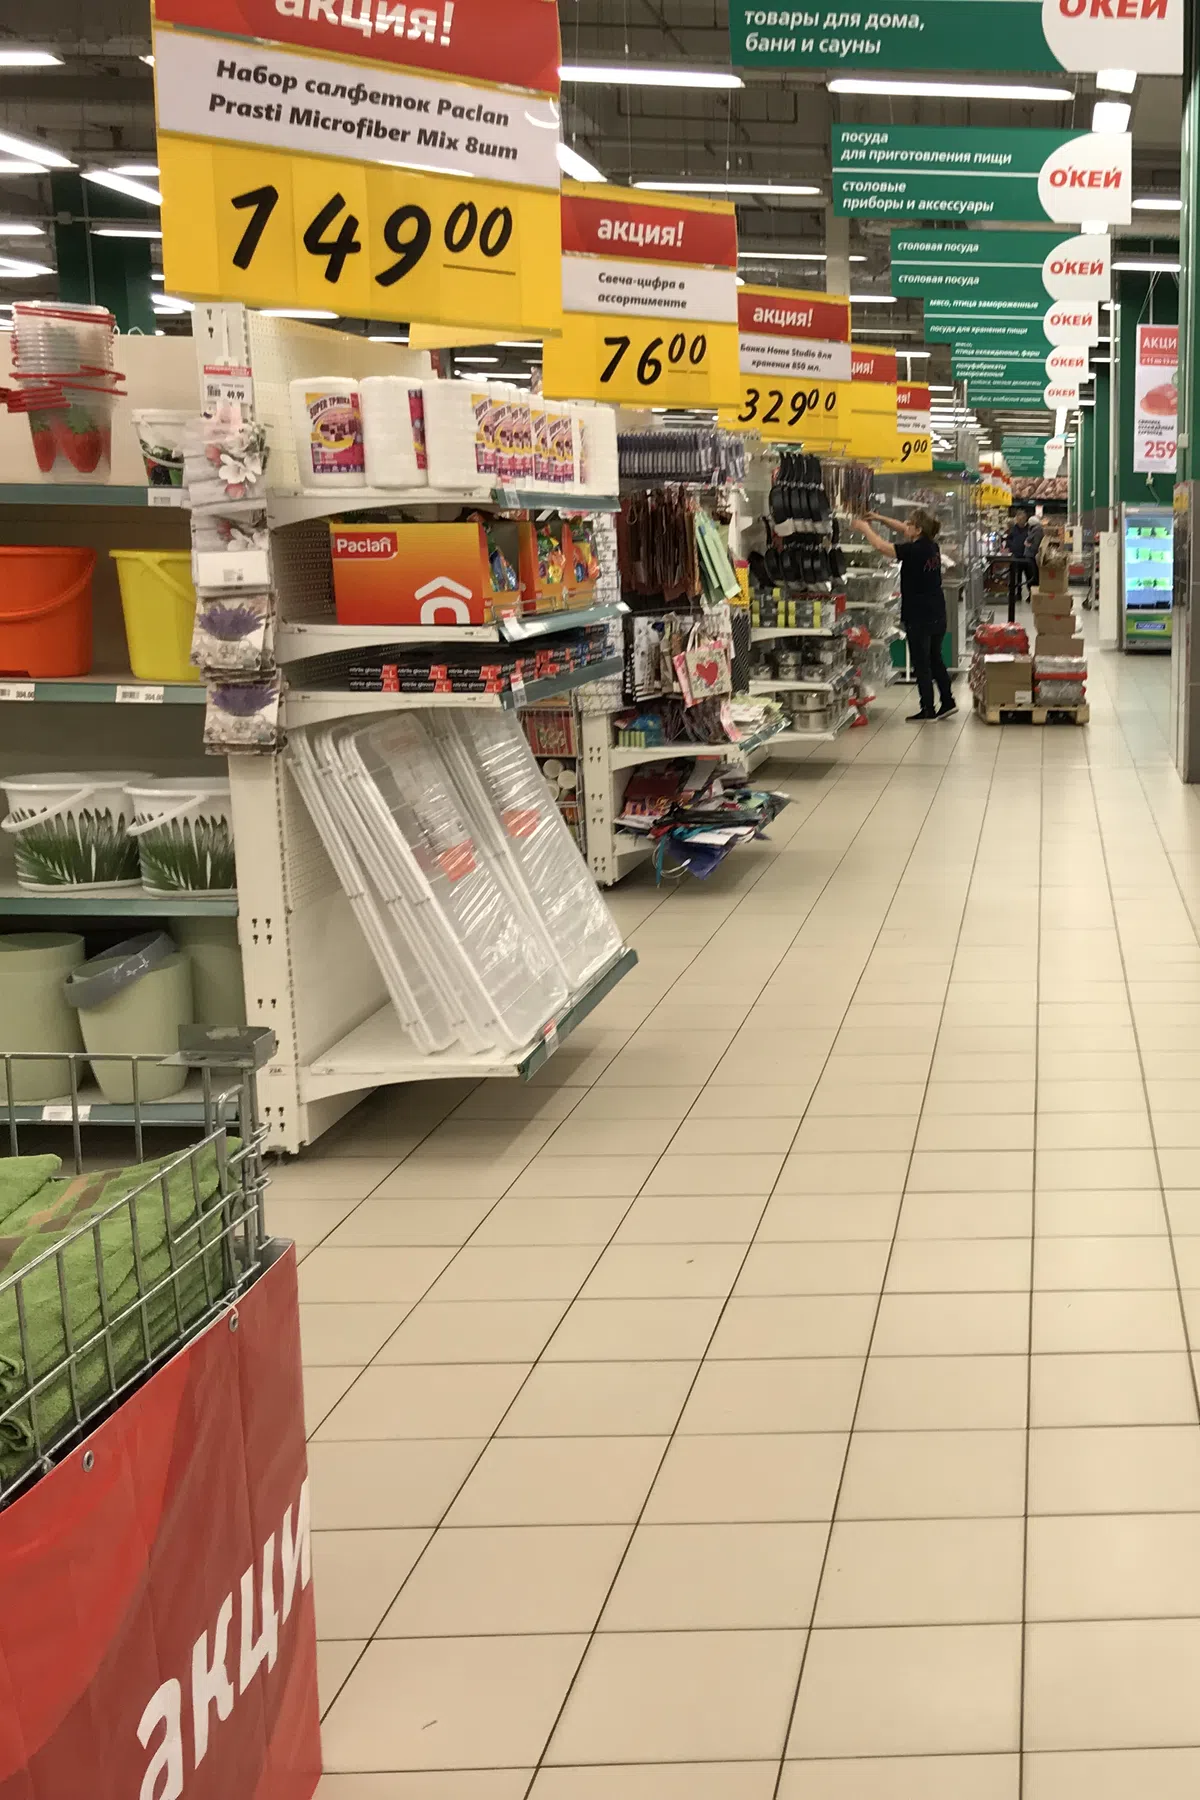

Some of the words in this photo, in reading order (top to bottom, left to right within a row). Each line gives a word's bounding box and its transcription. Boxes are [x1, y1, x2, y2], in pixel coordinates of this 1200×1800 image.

[744, 9, 819, 27] товары
[823, 12, 861, 30] для
[865, 13, 925, 31] дома,
[745, 34, 796, 53] бани
[801, 39, 813, 53] и
[819, 38, 881, 56] сауны
[216, 59, 298, 93] Набор
[305, 77, 431, 114] салфеток
[437, 97, 510, 127] Paclan
[208, 94, 282, 122] Prasti
[289, 107, 411, 143] Microfiber
[416, 127, 460, 151] Mix
[464, 137, 519, 161] 8шт
[841, 131, 888, 146] посуда
[841, 148, 866, 162] для
[869, 149, 971, 165] приготовления
[974, 151, 1012, 166] пищи
[843, 180, 906, 194] столовые
[843, 196, 904, 213] приборы
[907, 200, 915, 209] и
[918, 199, 994, 214] аксессуары
[597, 217, 684, 248] акция!
[898, 242, 942, 252] столовая
[944, 243, 979, 253] посуда
[598, 271, 676, 292] Свеча-цифра
[679, 281, 686, 290] в
[899, 275, 942, 285] столовая
[945, 275, 980, 286] посуда
[597, 292, 687, 311] ассортименте
[753, 306, 814, 328] акция!
[740, 343, 765, 354] Банка
[767, 346, 790, 356] Home
[337, 536, 391, 552] Paclan
